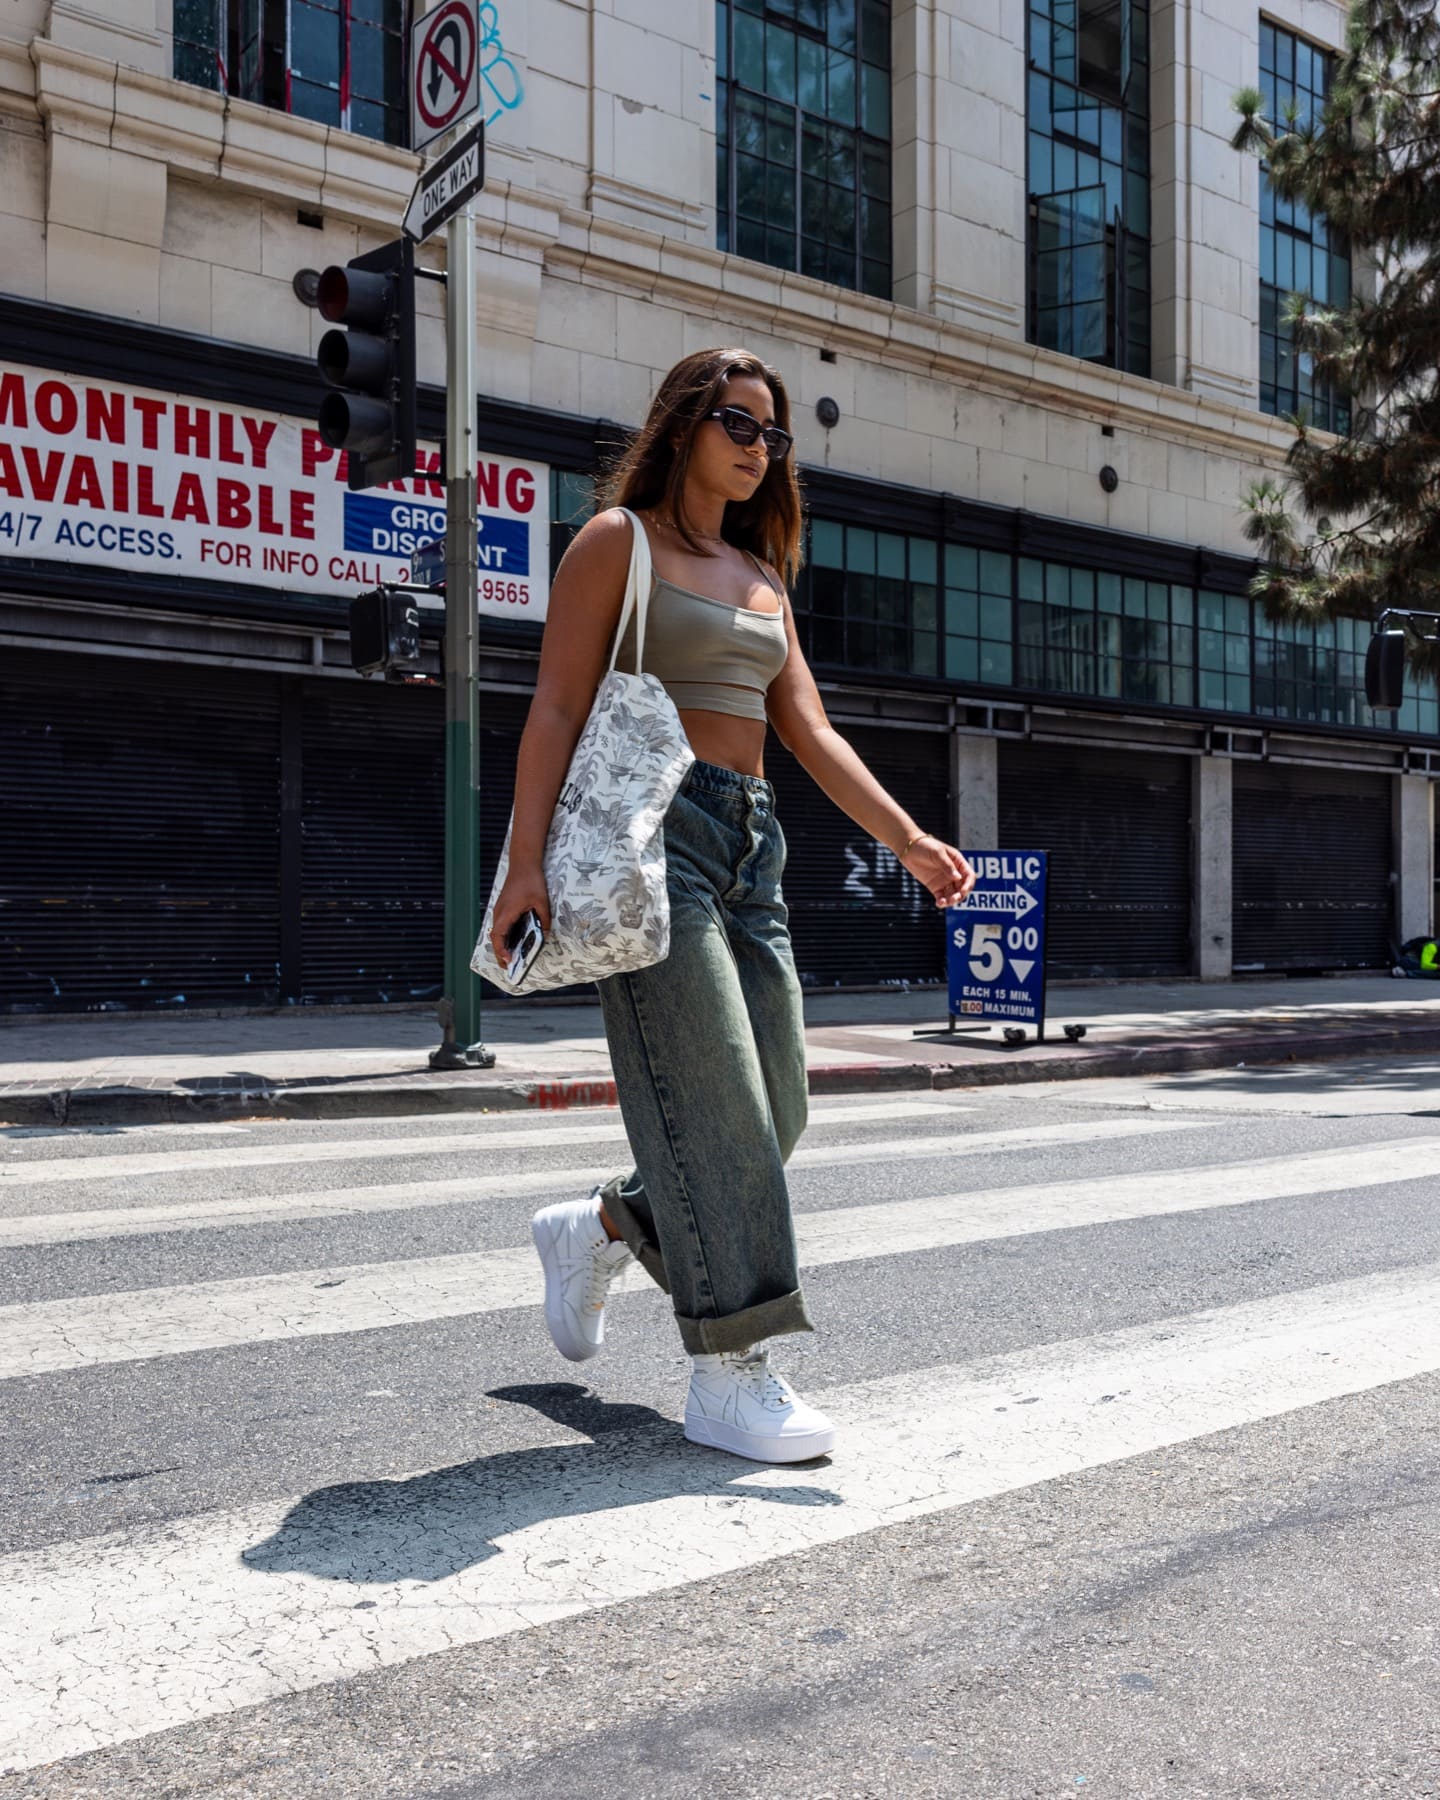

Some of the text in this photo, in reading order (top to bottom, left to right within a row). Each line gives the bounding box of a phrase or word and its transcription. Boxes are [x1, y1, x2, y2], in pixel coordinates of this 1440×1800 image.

[424, 151, 476, 217] ONE WAY
[0, 442, 315, 540] AVAILABLE
[302, 427, 536, 514] PKNG
[55, 518, 182, 560] ACCESS.
[391, 505, 484, 534] GRO
[200, 539, 251, 569] FOR
[263, 547, 319, 577] INFO
[328, 557, 383, 586] CALL
[967, 856, 1040, 880] UBLIC
[962, 985, 1032, 1002] EACH 15 MIN.
[984, 1002, 1035, 1017] MAXIMUM
